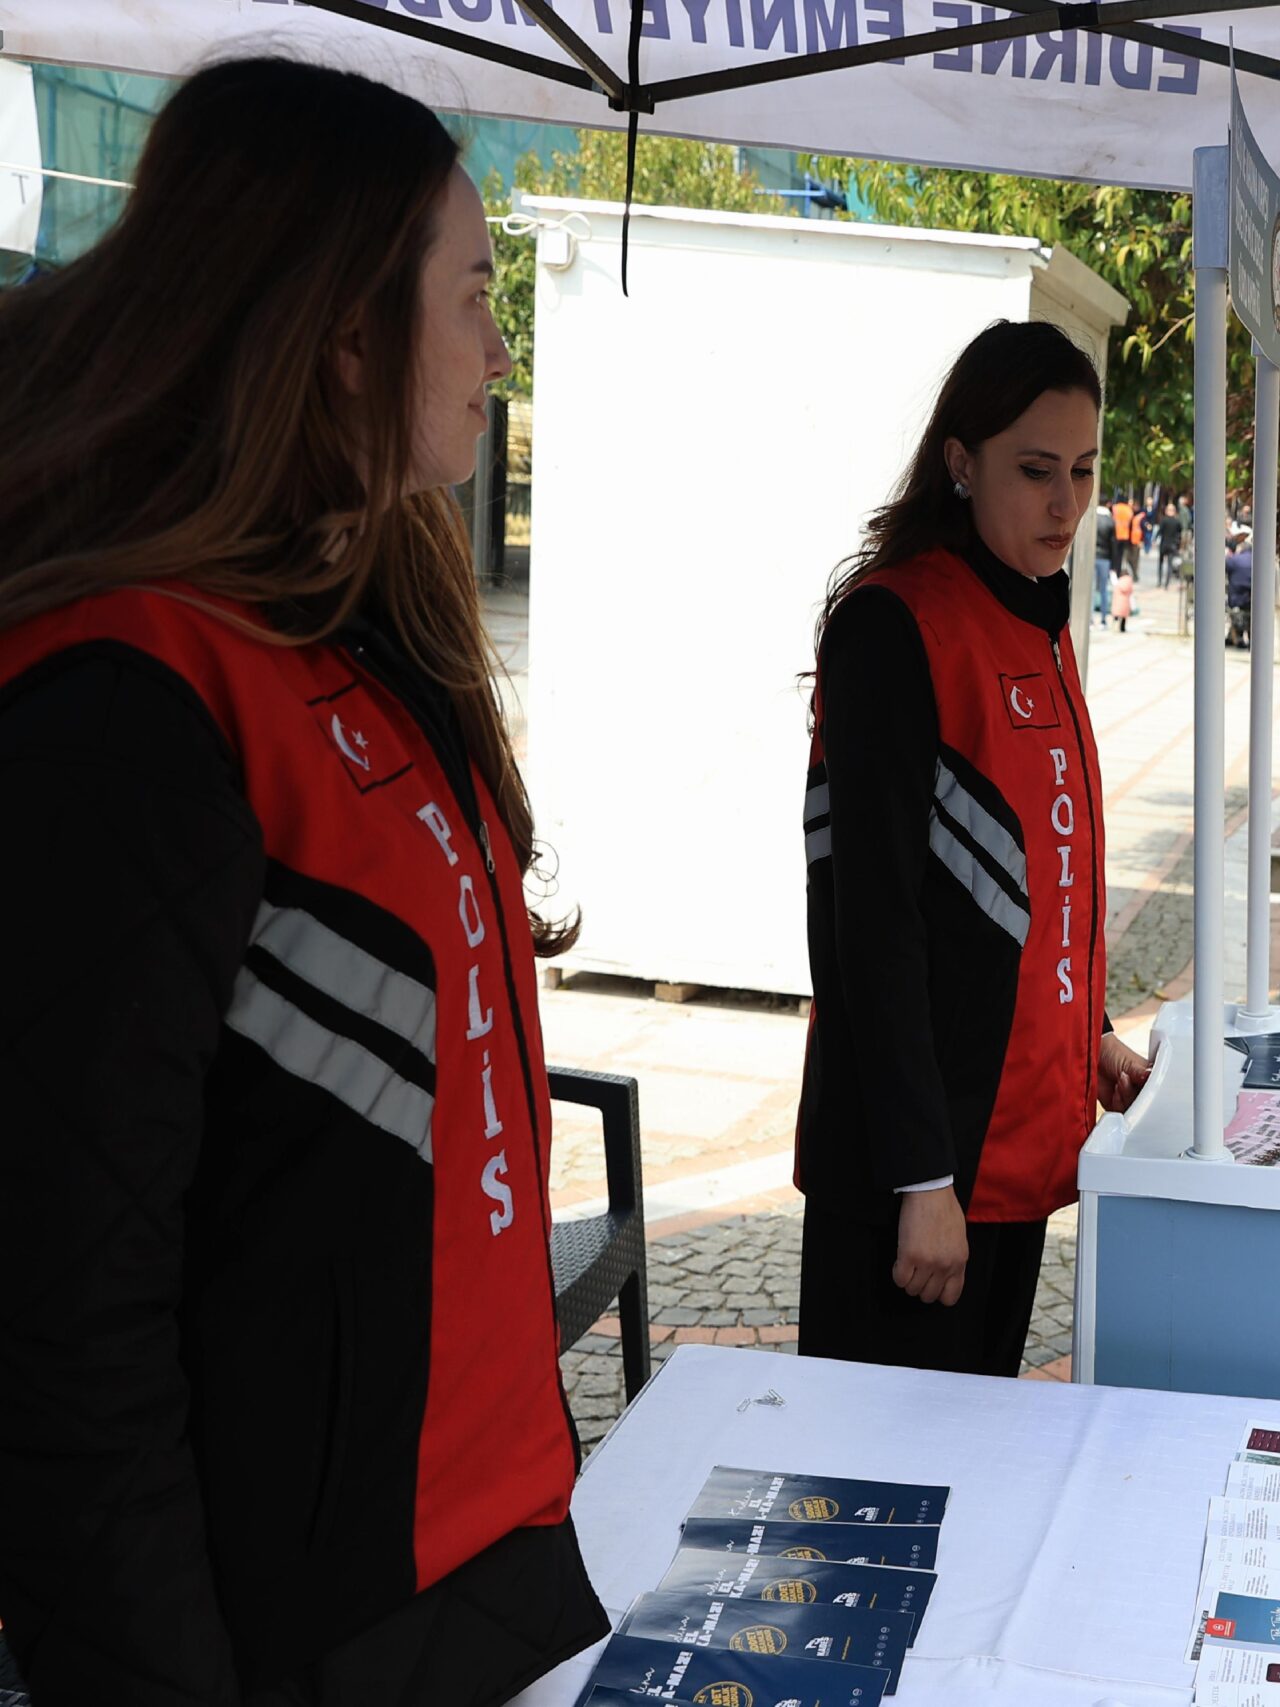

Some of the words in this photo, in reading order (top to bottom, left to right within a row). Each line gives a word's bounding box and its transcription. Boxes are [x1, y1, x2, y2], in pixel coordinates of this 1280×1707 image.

[1049, 748, 1074, 1004] POLİS
[416, 801, 514, 1236] POLİS
[683, 1631, 699, 1644] EL
[718, 1581, 734, 1594] EL
